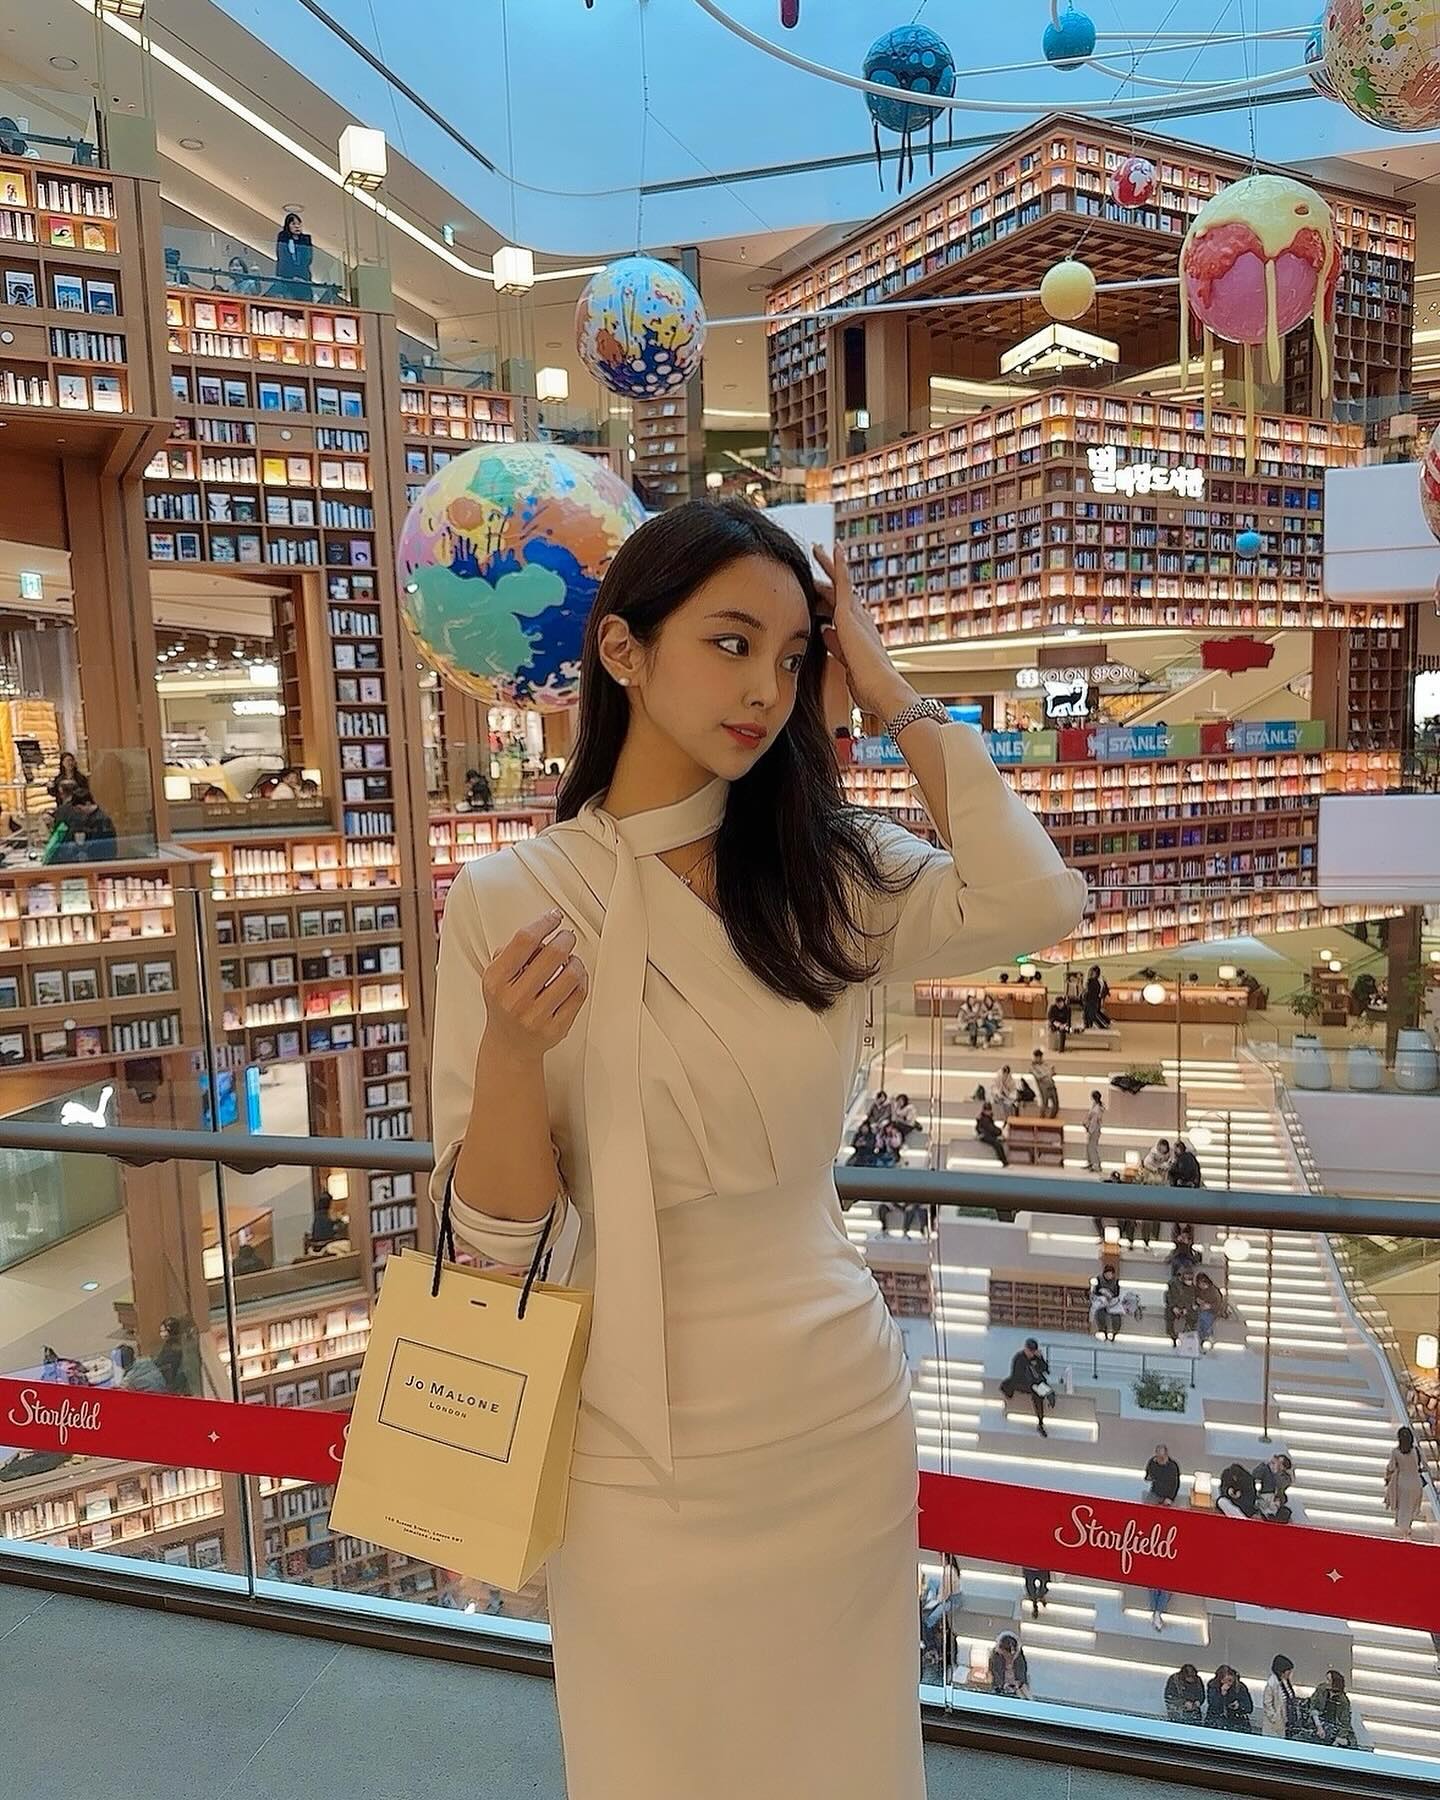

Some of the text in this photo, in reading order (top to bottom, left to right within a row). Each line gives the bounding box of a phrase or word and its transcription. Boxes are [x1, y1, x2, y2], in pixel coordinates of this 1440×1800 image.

[986, 740, 1031, 757] ANLEY
[1245, 729, 1304, 745] STANLEY
[430, 1382, 500, 1413] MALONE
[8, 1388, 101, 1446] Starfield
[1054, 1504, 1178, 1575] Starfield
